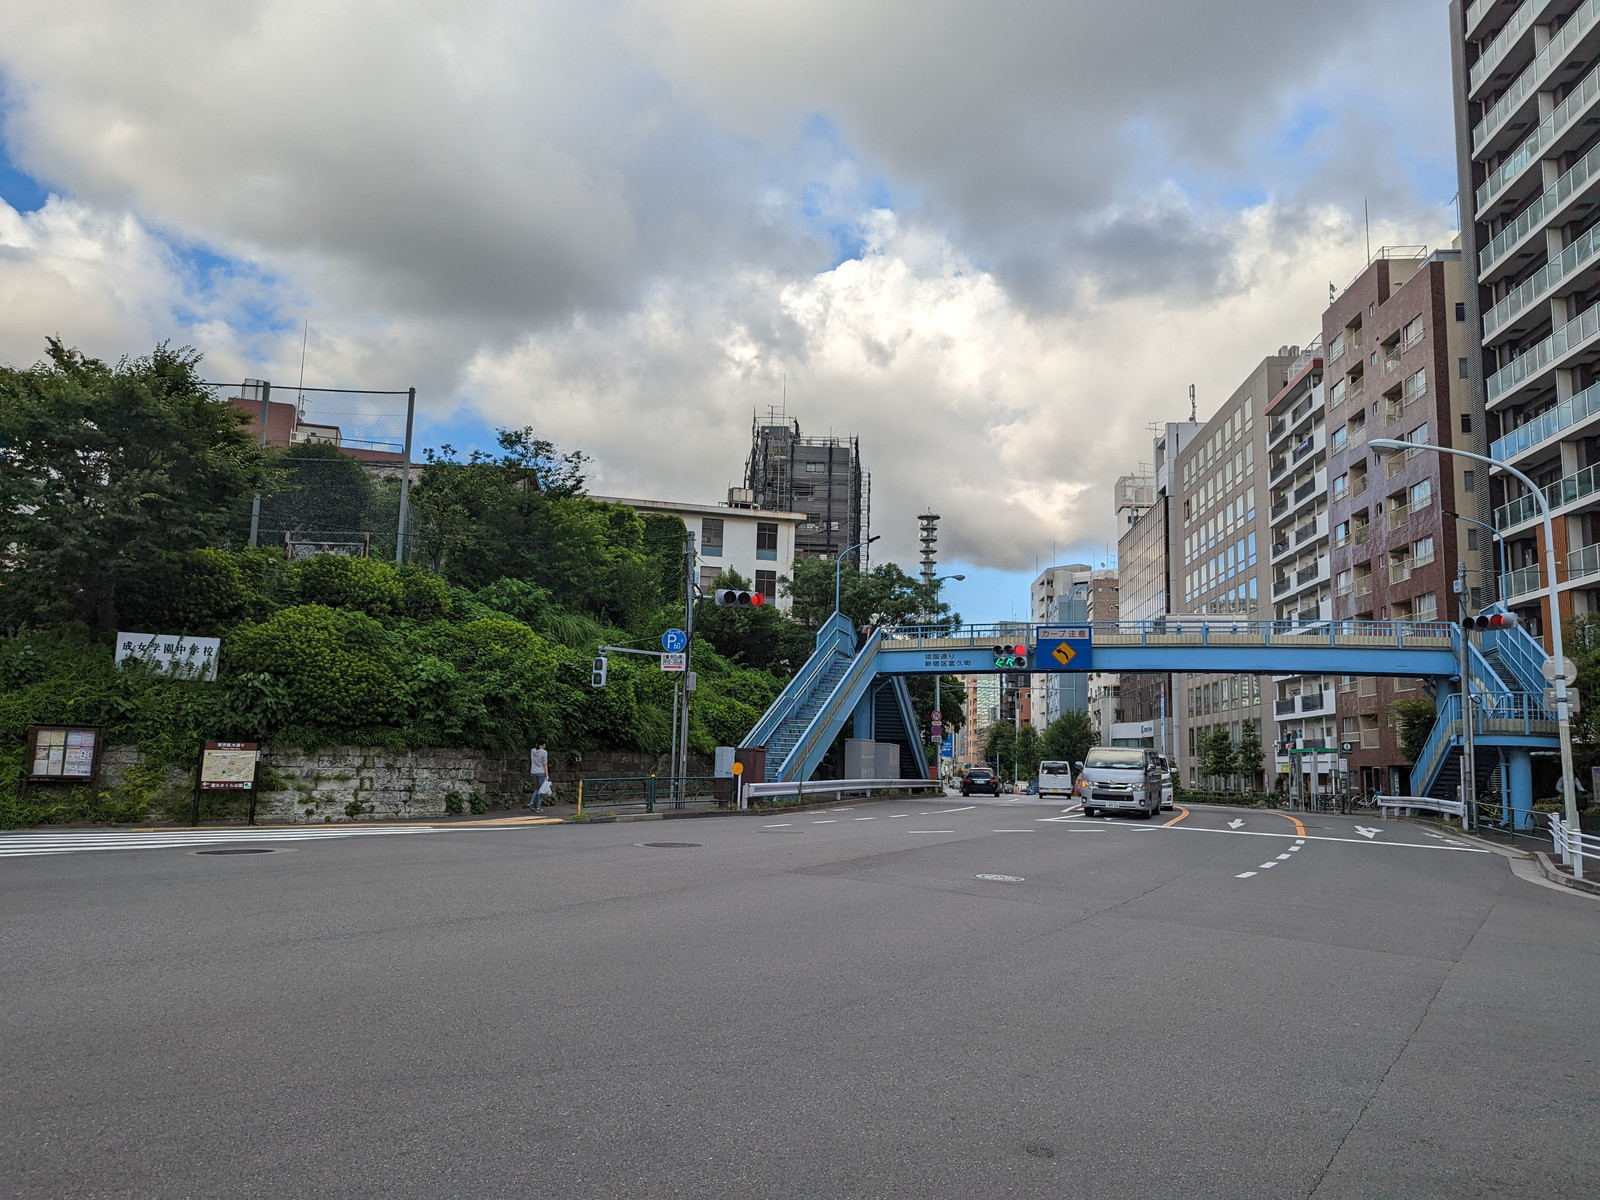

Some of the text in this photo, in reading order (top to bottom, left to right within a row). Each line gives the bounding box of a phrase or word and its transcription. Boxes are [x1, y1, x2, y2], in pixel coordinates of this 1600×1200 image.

[1041, 629, 1087, 638] カーブ注意
[121, 640, 215, 657] 成女学園中学校
[667, 634, 677, 649] P
[673, 642, 681, 650] 60
